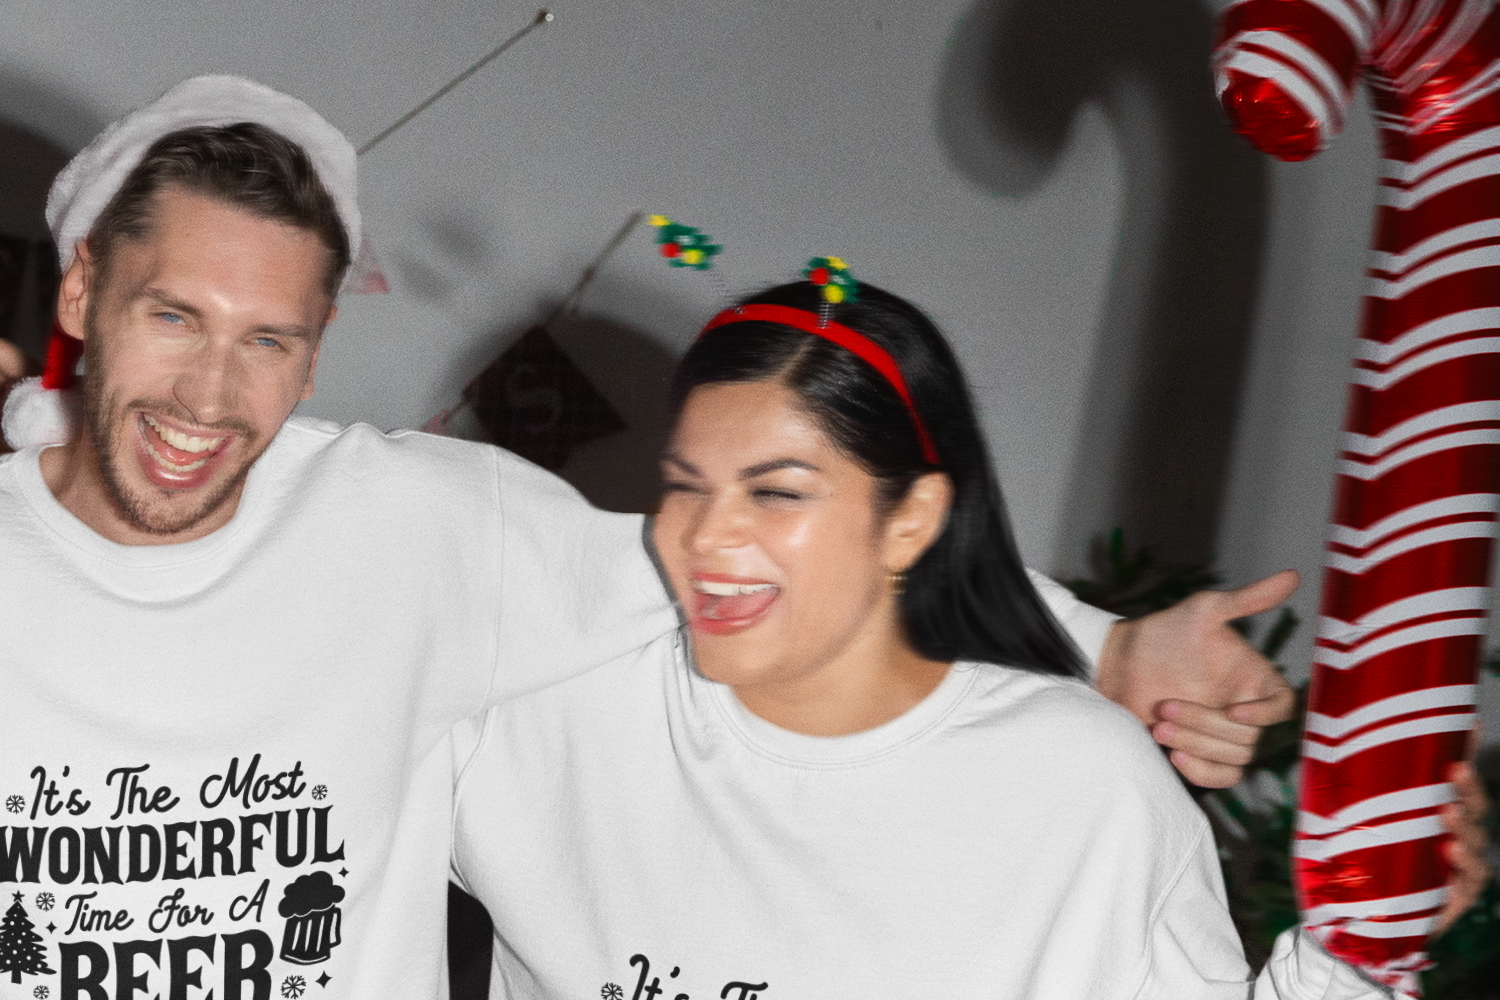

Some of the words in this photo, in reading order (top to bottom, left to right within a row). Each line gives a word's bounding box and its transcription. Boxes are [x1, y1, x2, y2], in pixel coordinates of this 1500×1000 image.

[30, 765, 91, 821] It's
[106, 763, 180, 821] The
[199, 753, 307, 809] Most
[64, 890, 135, 936] Time
[148, 887, 214, 934] For
[228, 878, 270, 923] A
